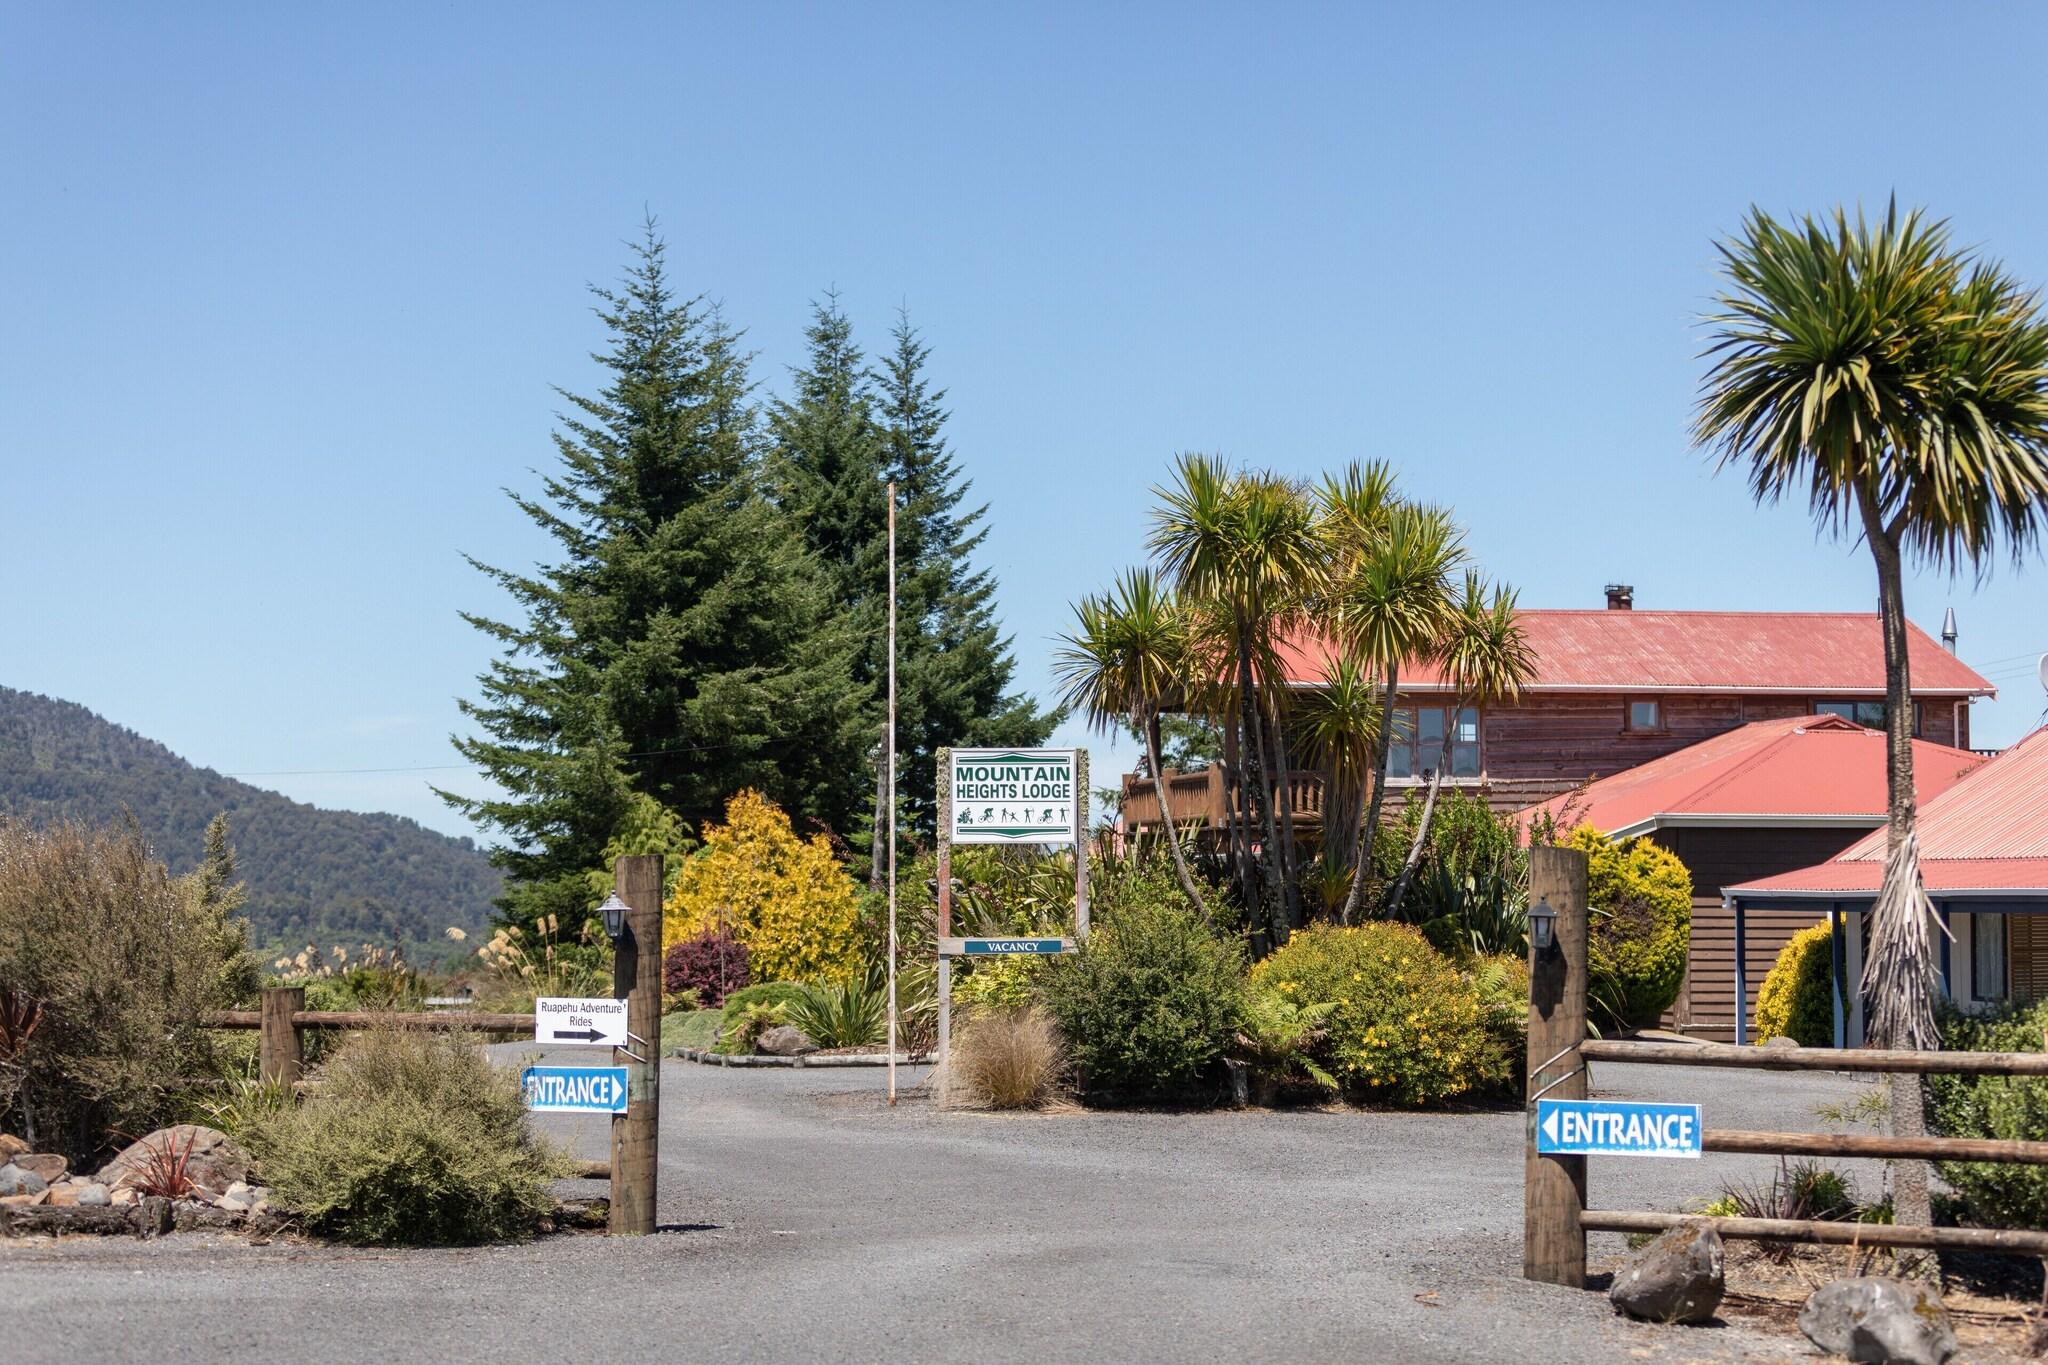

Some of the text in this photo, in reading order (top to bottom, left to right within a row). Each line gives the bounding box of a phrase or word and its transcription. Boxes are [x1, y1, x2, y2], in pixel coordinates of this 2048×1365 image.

[956, 767, 1070, 781] MOUNTAIN
[956, 784, 1071, 799] HEIGHTS LODGE
[987, 942, 1040, 952] VACANCY
[541, 1001, 622, 1014] Ruapehu Adventure
[569, 1015, 593, 1027] Rides
[1562, 1111, 1693, 1148] ENTRANCE
